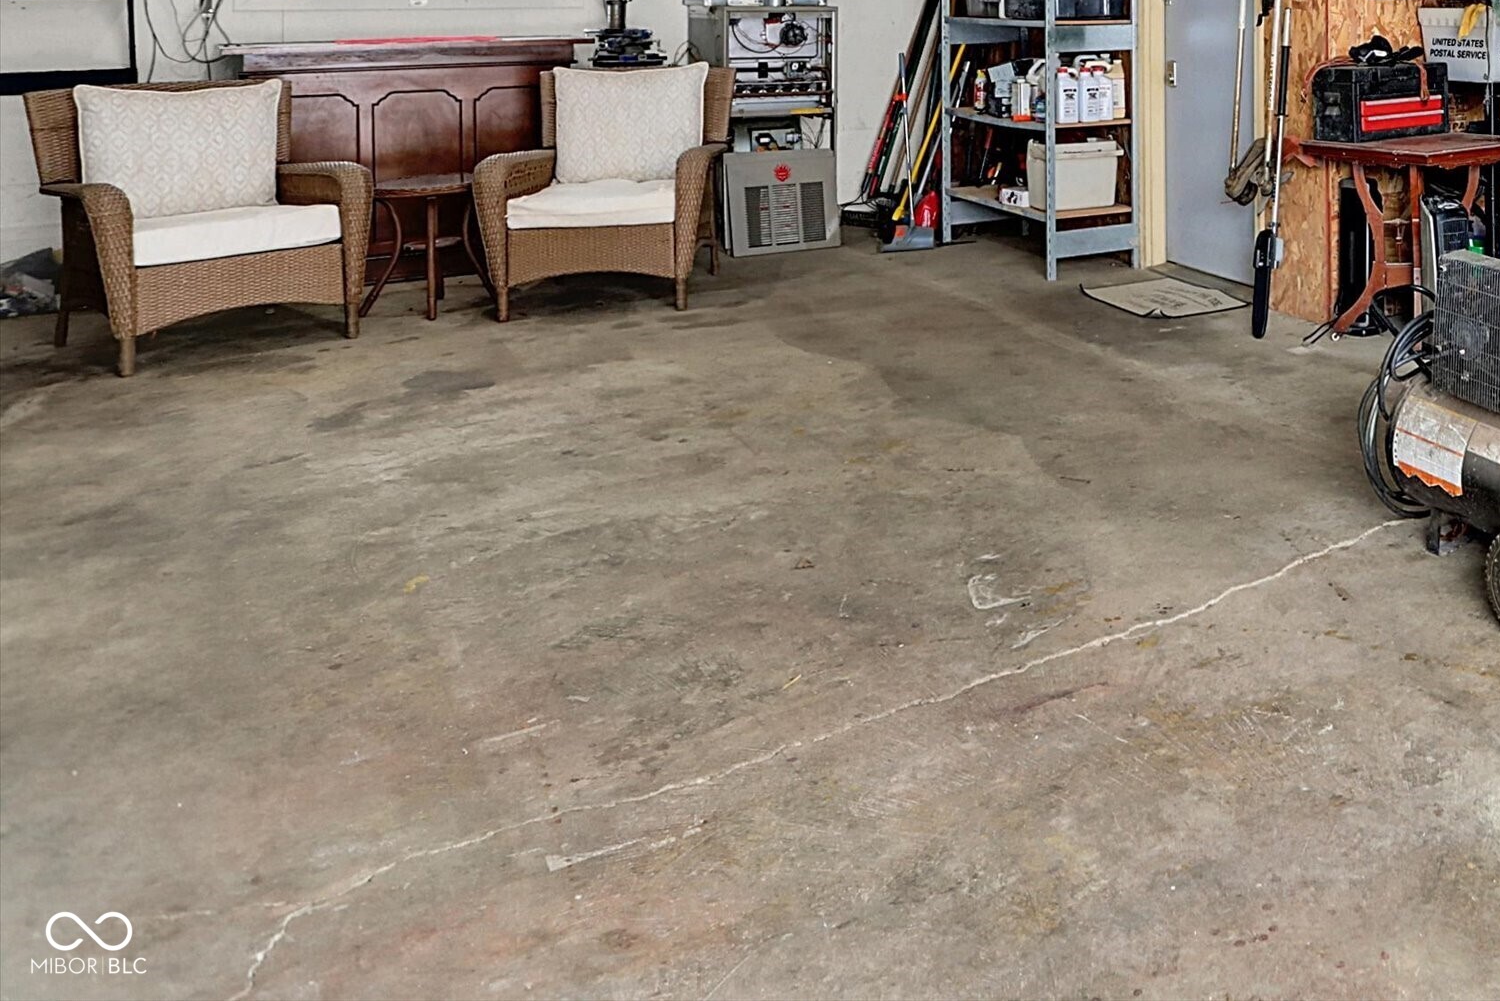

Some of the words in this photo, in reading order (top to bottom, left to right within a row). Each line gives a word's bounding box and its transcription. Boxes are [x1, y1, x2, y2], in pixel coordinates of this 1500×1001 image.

[1432, 37, 1457, 47] UNITED
[1457, 38, 1484, 48] STATES
[1430, 48, 1456, 58] POSTAL
[1457, 49, 1487, 60] SERVICE
